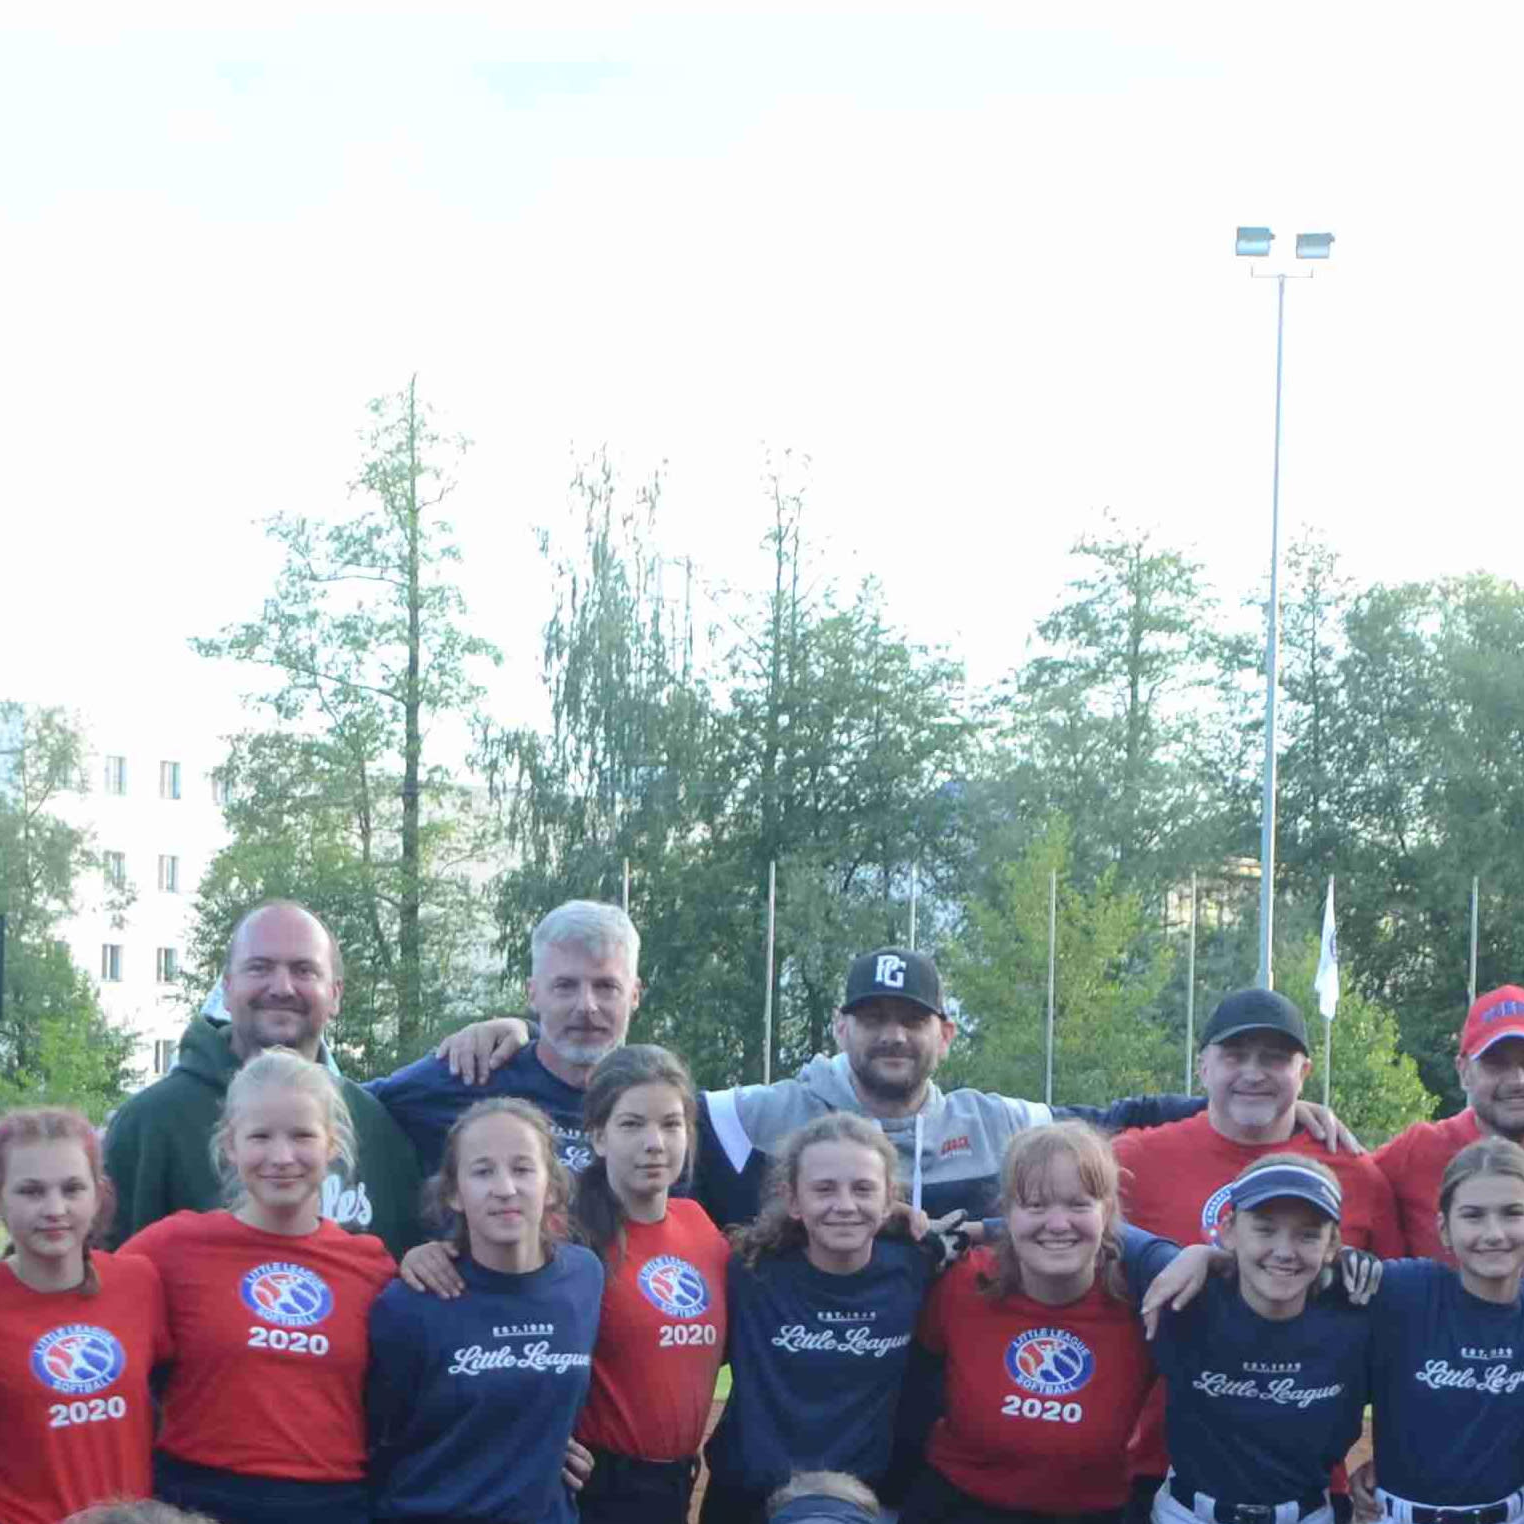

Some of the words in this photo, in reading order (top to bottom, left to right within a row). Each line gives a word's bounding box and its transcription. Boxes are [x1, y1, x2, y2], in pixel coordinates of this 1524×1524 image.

[244, 1262, 280, 1283] LITTLE
[248, 1326, 329, 1357] 2020
[659, 1324, 717, 1348] 2020
[771, 1325, 837, 1353] Little
[838, 1326, 911, 1358] League
[1012, 1328, 1048, 1349] LITTLE
[448, 1345, 516, 1376] Little
[1415, 1359, 1477, 1389] Little
[52, 1373, 114, 1395] SOFTBALL
[1016, 1374, 1079, 1395] SOFTBALL
[1192, 1371, 1259, 1398] Little
[1259, 1378, 1344, 1408] League
[49, 1396, 126, 1428] 2020
[1001, 1395, 1083, 1424] 2020
